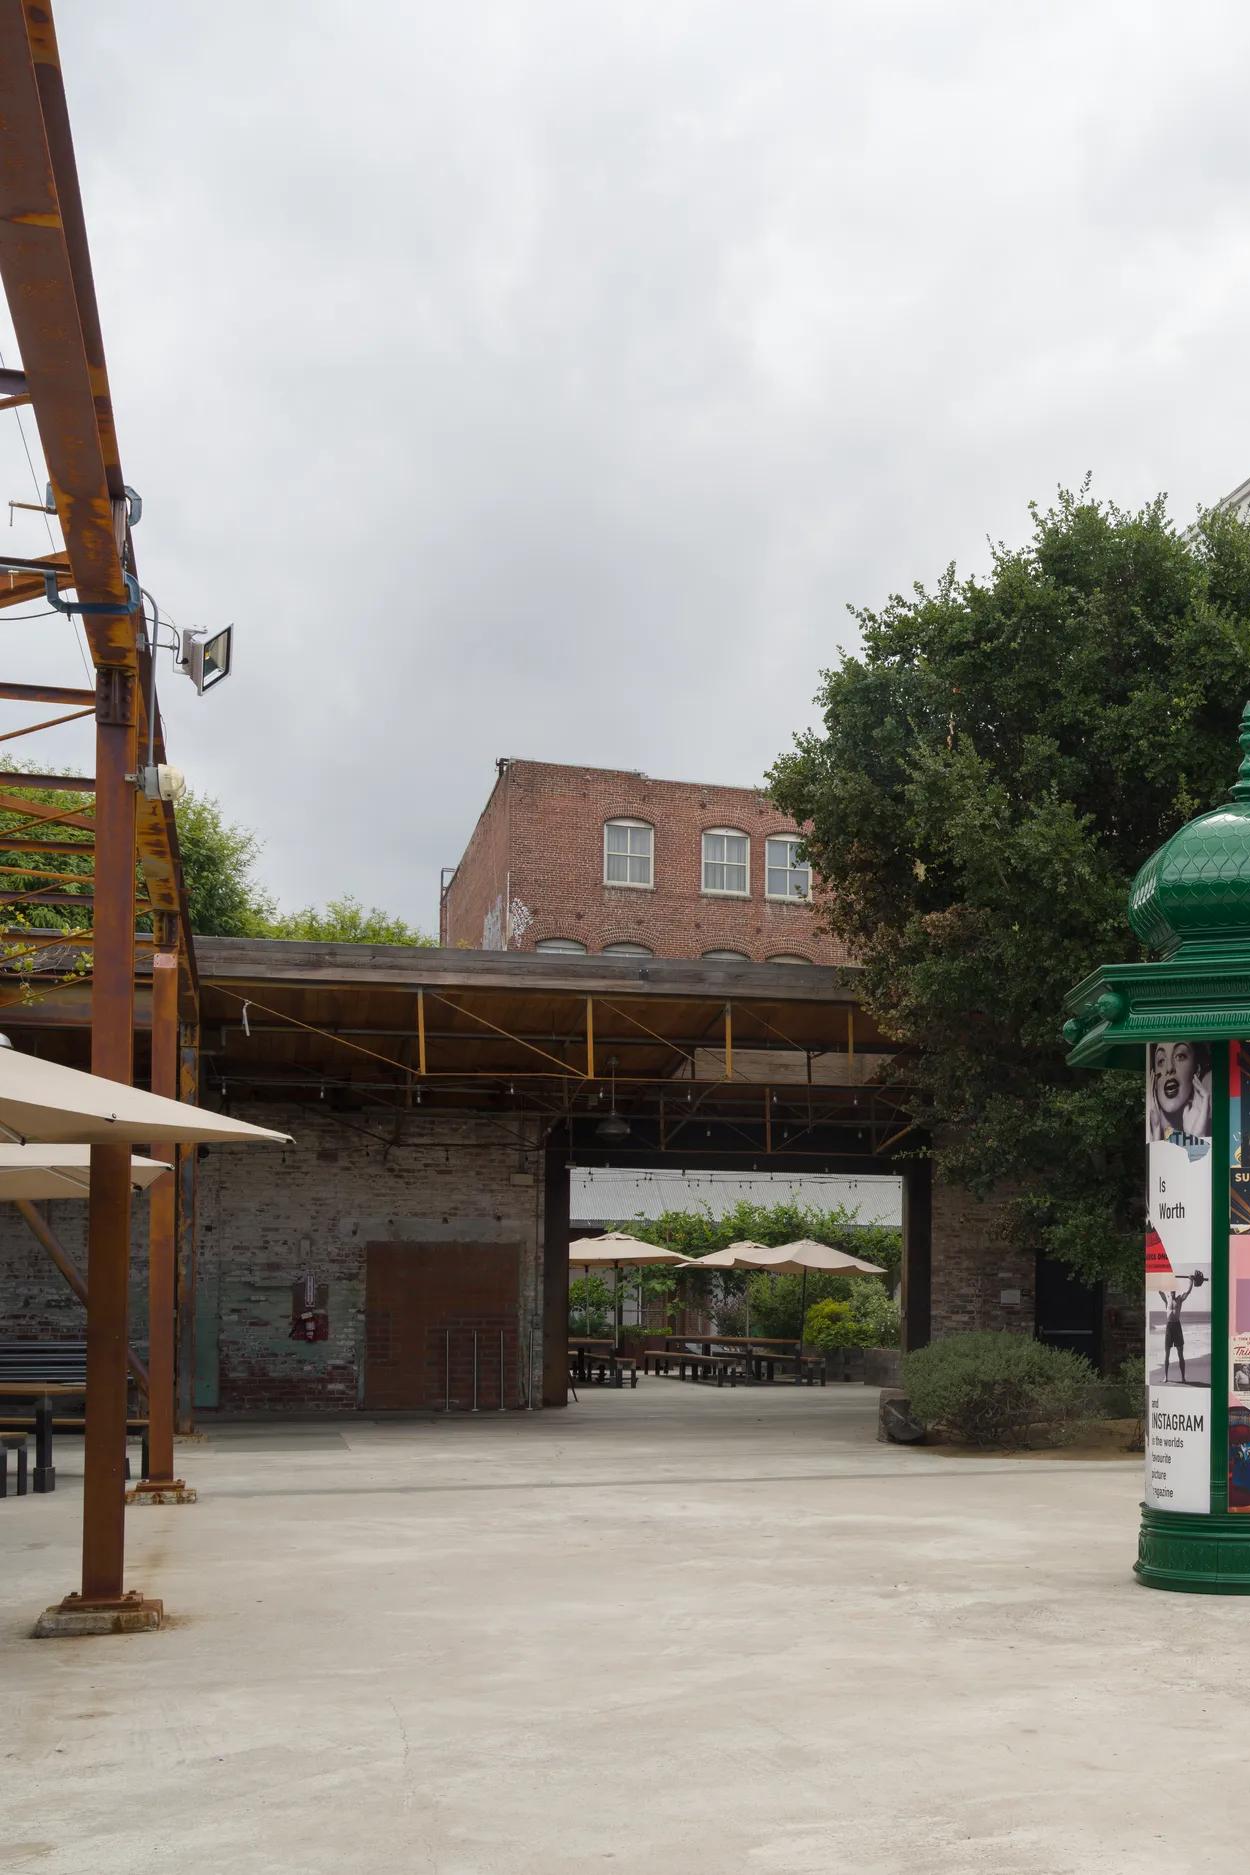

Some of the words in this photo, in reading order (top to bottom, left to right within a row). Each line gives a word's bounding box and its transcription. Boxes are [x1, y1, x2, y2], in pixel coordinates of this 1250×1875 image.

[1159, 1176, 1166, 1193] Is
[1159, 1201, 1185, 1220] Worth
[1152, 1412, 1204, 1433] INSTAGRAM
[1163, 1436, 1184, 1448] worlds
